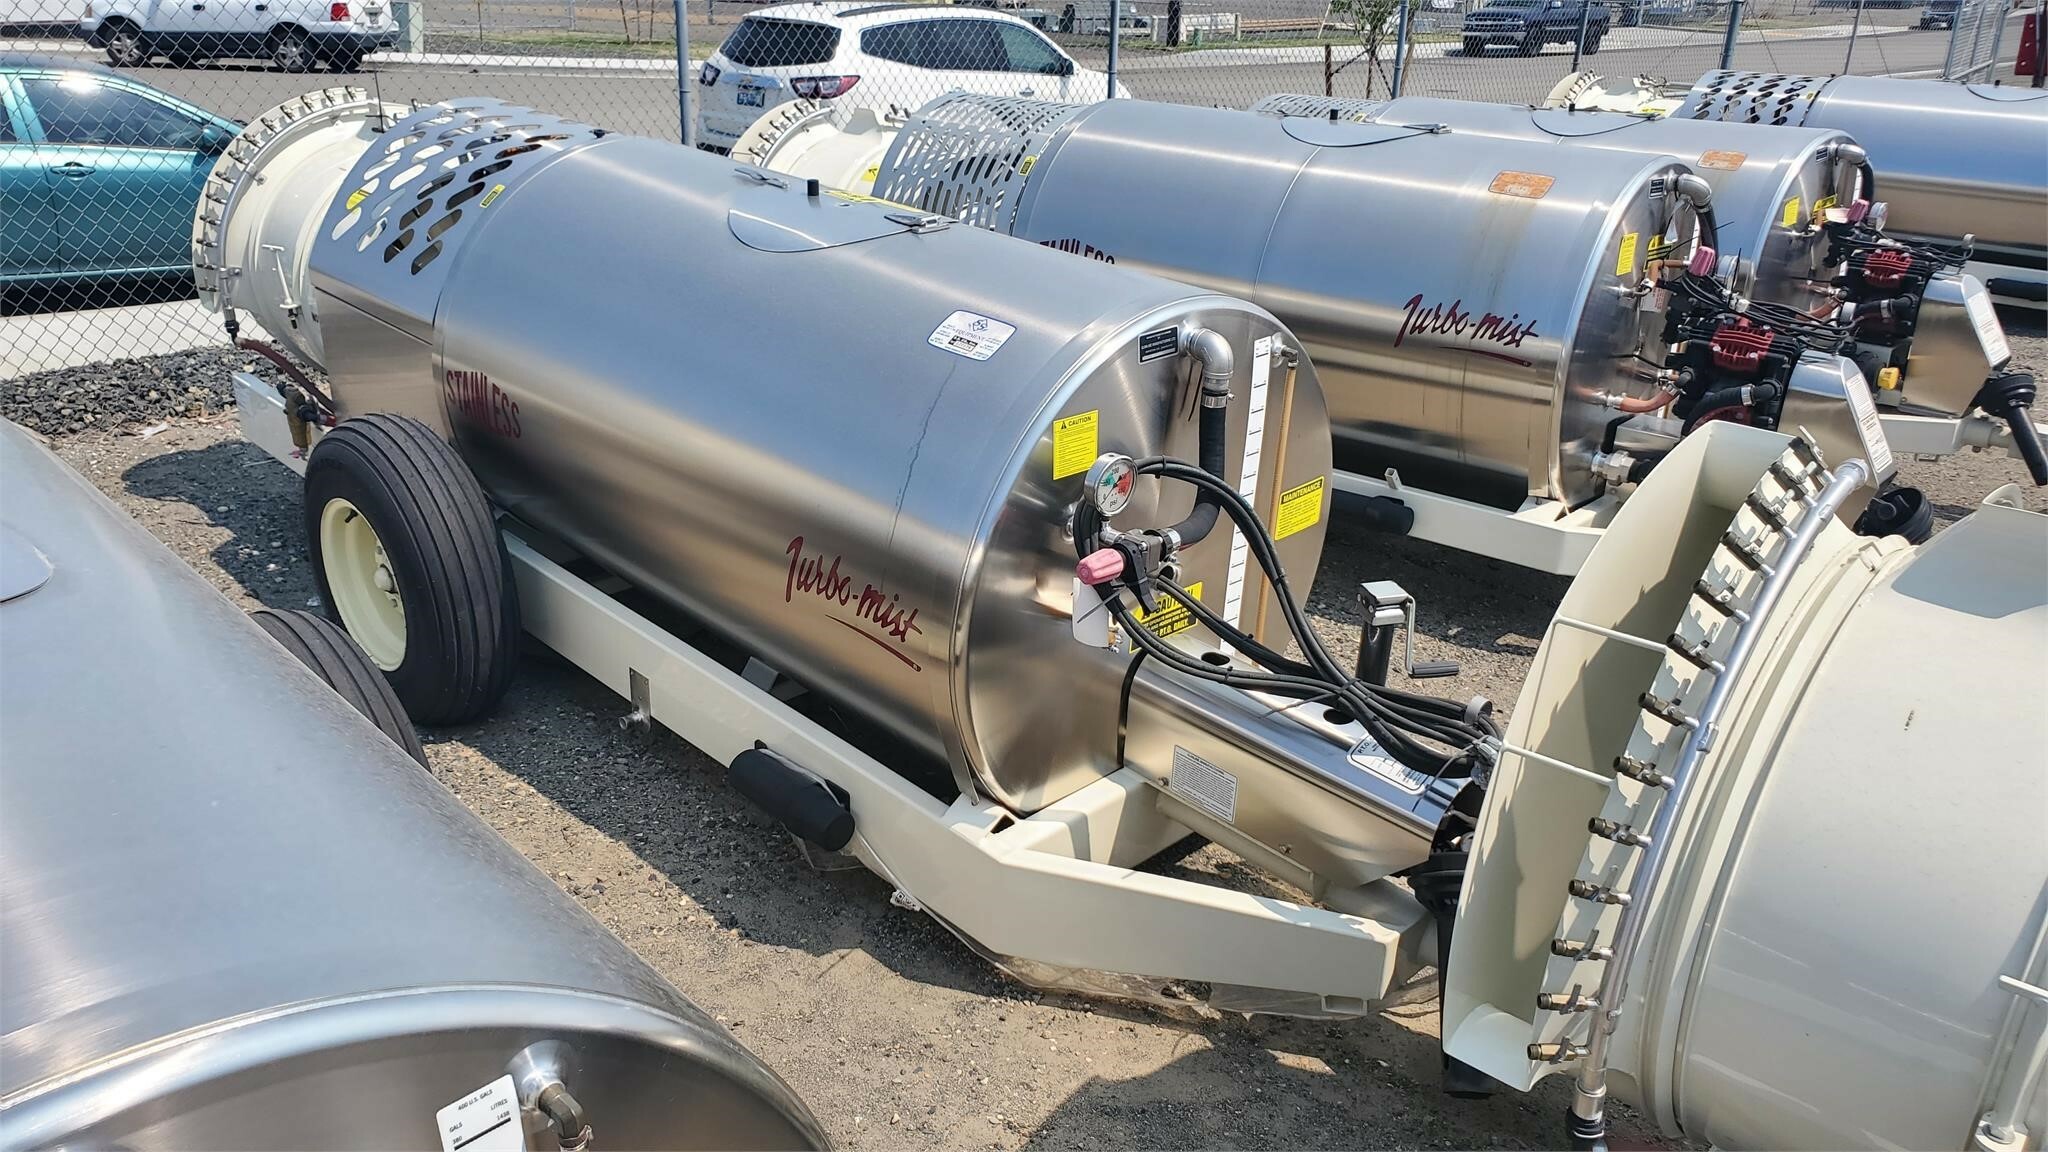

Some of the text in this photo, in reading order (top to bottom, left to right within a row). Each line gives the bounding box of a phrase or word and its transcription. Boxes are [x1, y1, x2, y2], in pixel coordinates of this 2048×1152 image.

[1394, 294, 1539, 348] Turbo-mist
[447, 370, 521, 439] STAINLESS
[1068, 416, 1092, 427] CAUTION
[1283, 482, 1321, 502] MAINTENANCE
[786, 536, 922, 642] Turbo-mist
[479, 1089, 493, 1099] GALS
[491, 1098, 508, 1110] LITRES
[449, 1121, 463, 1132] GALS
